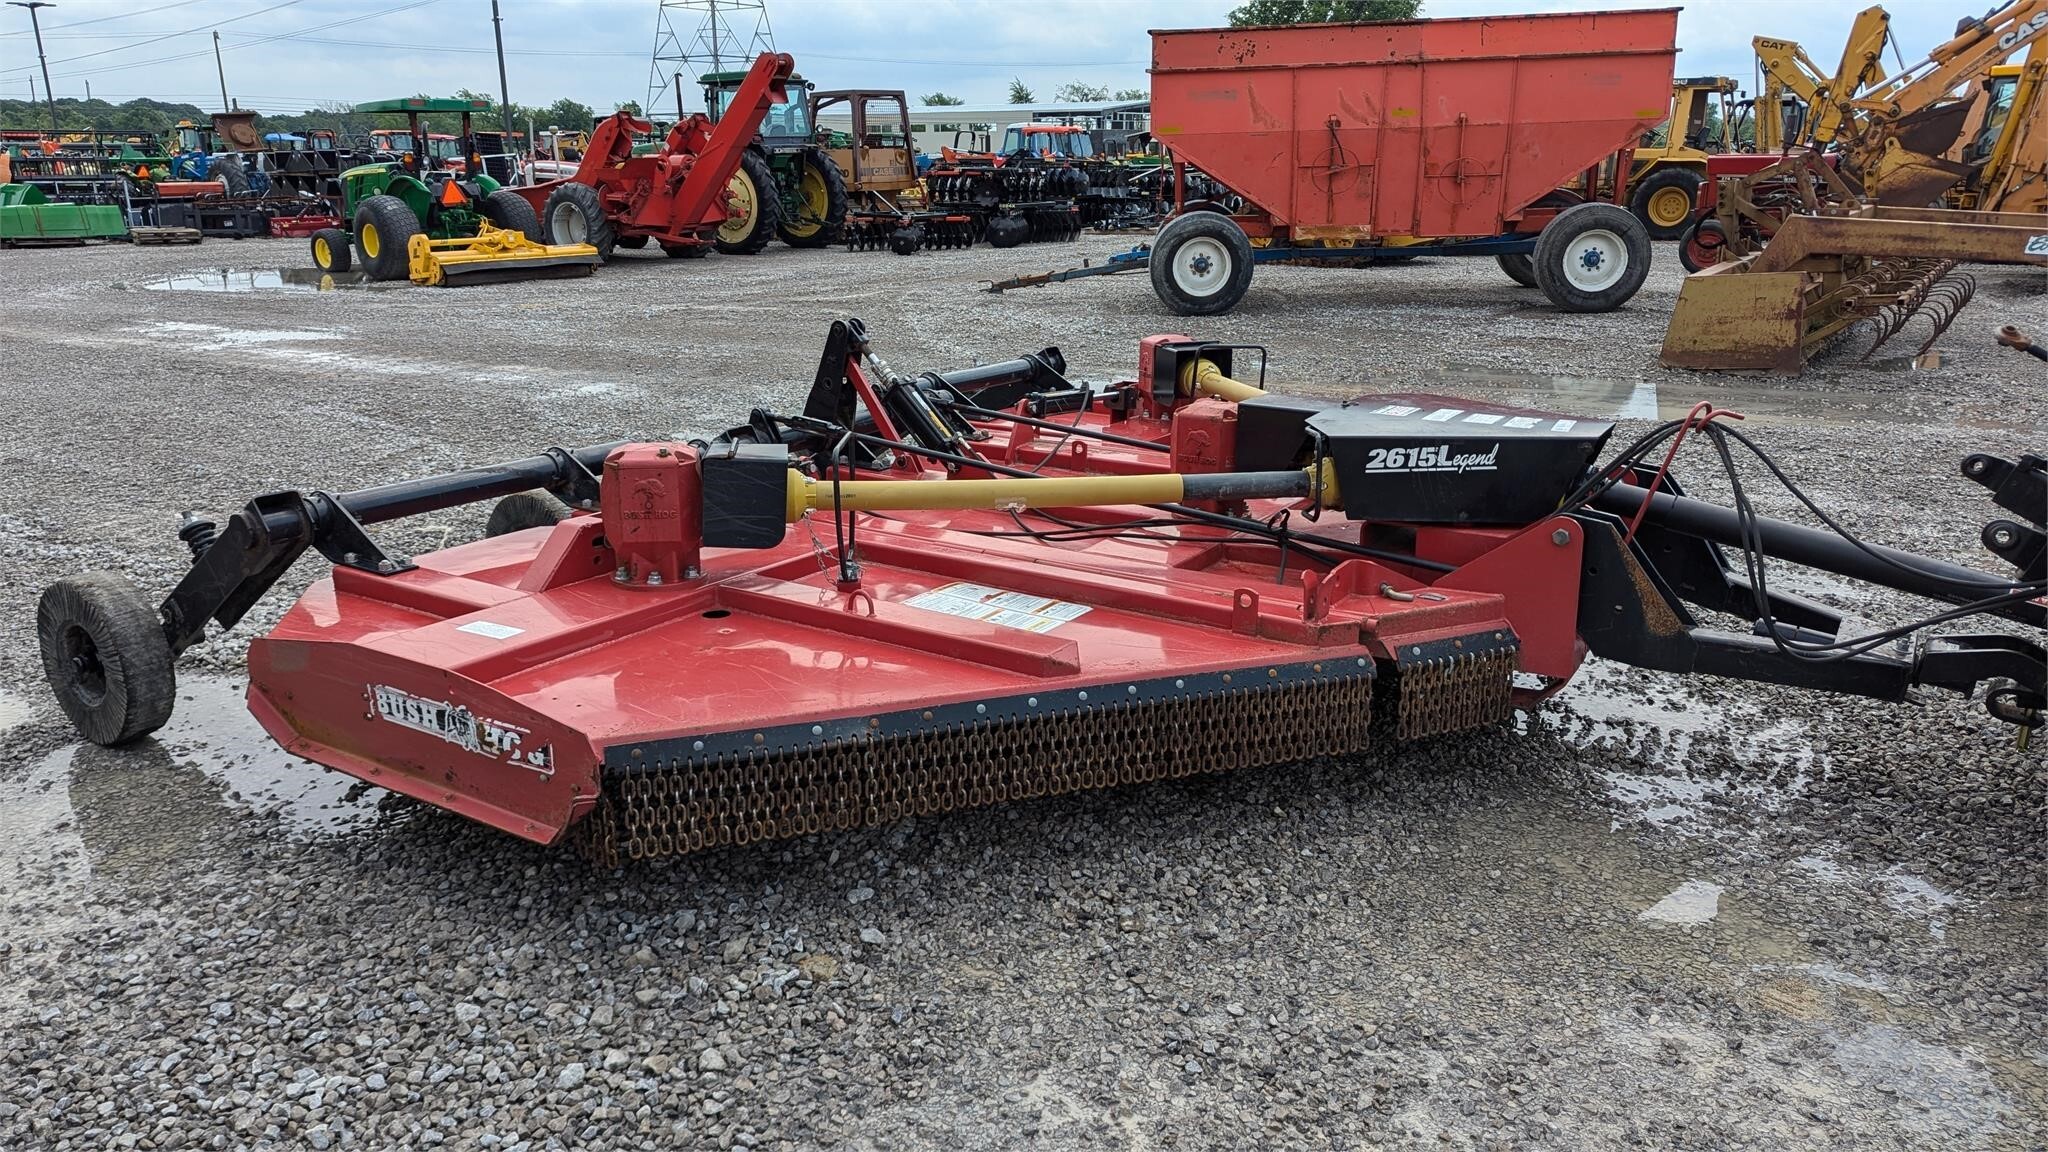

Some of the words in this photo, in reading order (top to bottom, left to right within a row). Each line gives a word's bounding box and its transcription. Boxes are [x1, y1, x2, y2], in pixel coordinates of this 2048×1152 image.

[1761, 40, 1787, 50] CAT
[873, 167, 895, 176] CASE
[377, 691, 439, 729] BUSH
